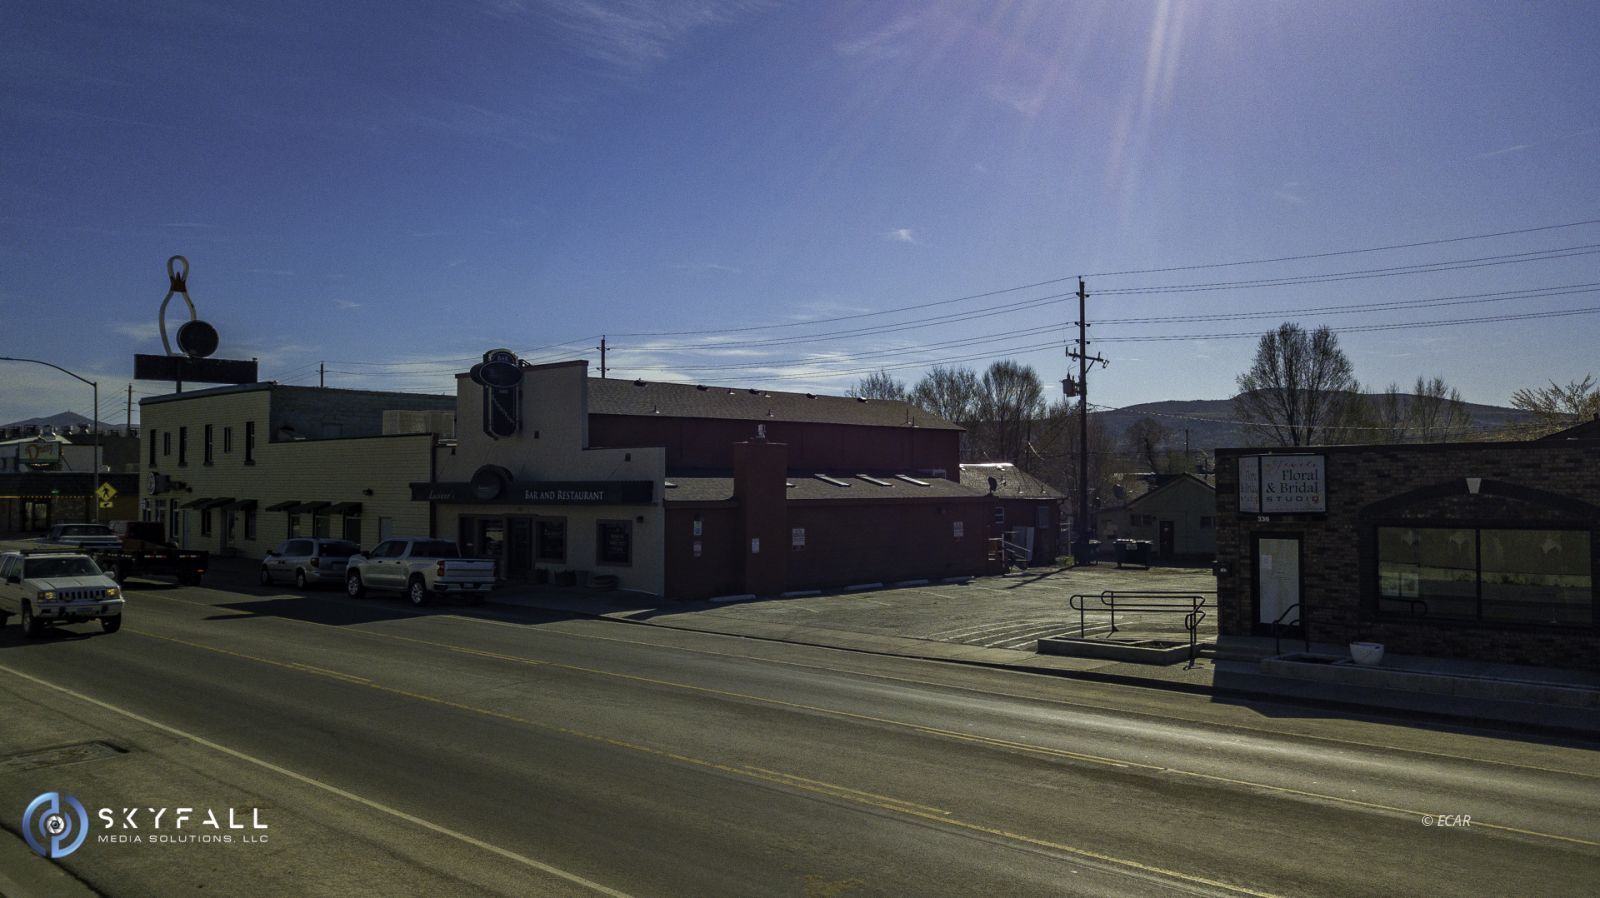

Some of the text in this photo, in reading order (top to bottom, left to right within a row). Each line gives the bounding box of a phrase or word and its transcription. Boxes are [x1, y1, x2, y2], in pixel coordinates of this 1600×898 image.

[1282, 469, 1318, 481] Floral
[1266, 481, 1318, 493] & Bridal
[525, 489, 604, 501] BAR AND RESTAURANT
[1266, 495, 1320, 504] STUDIO
